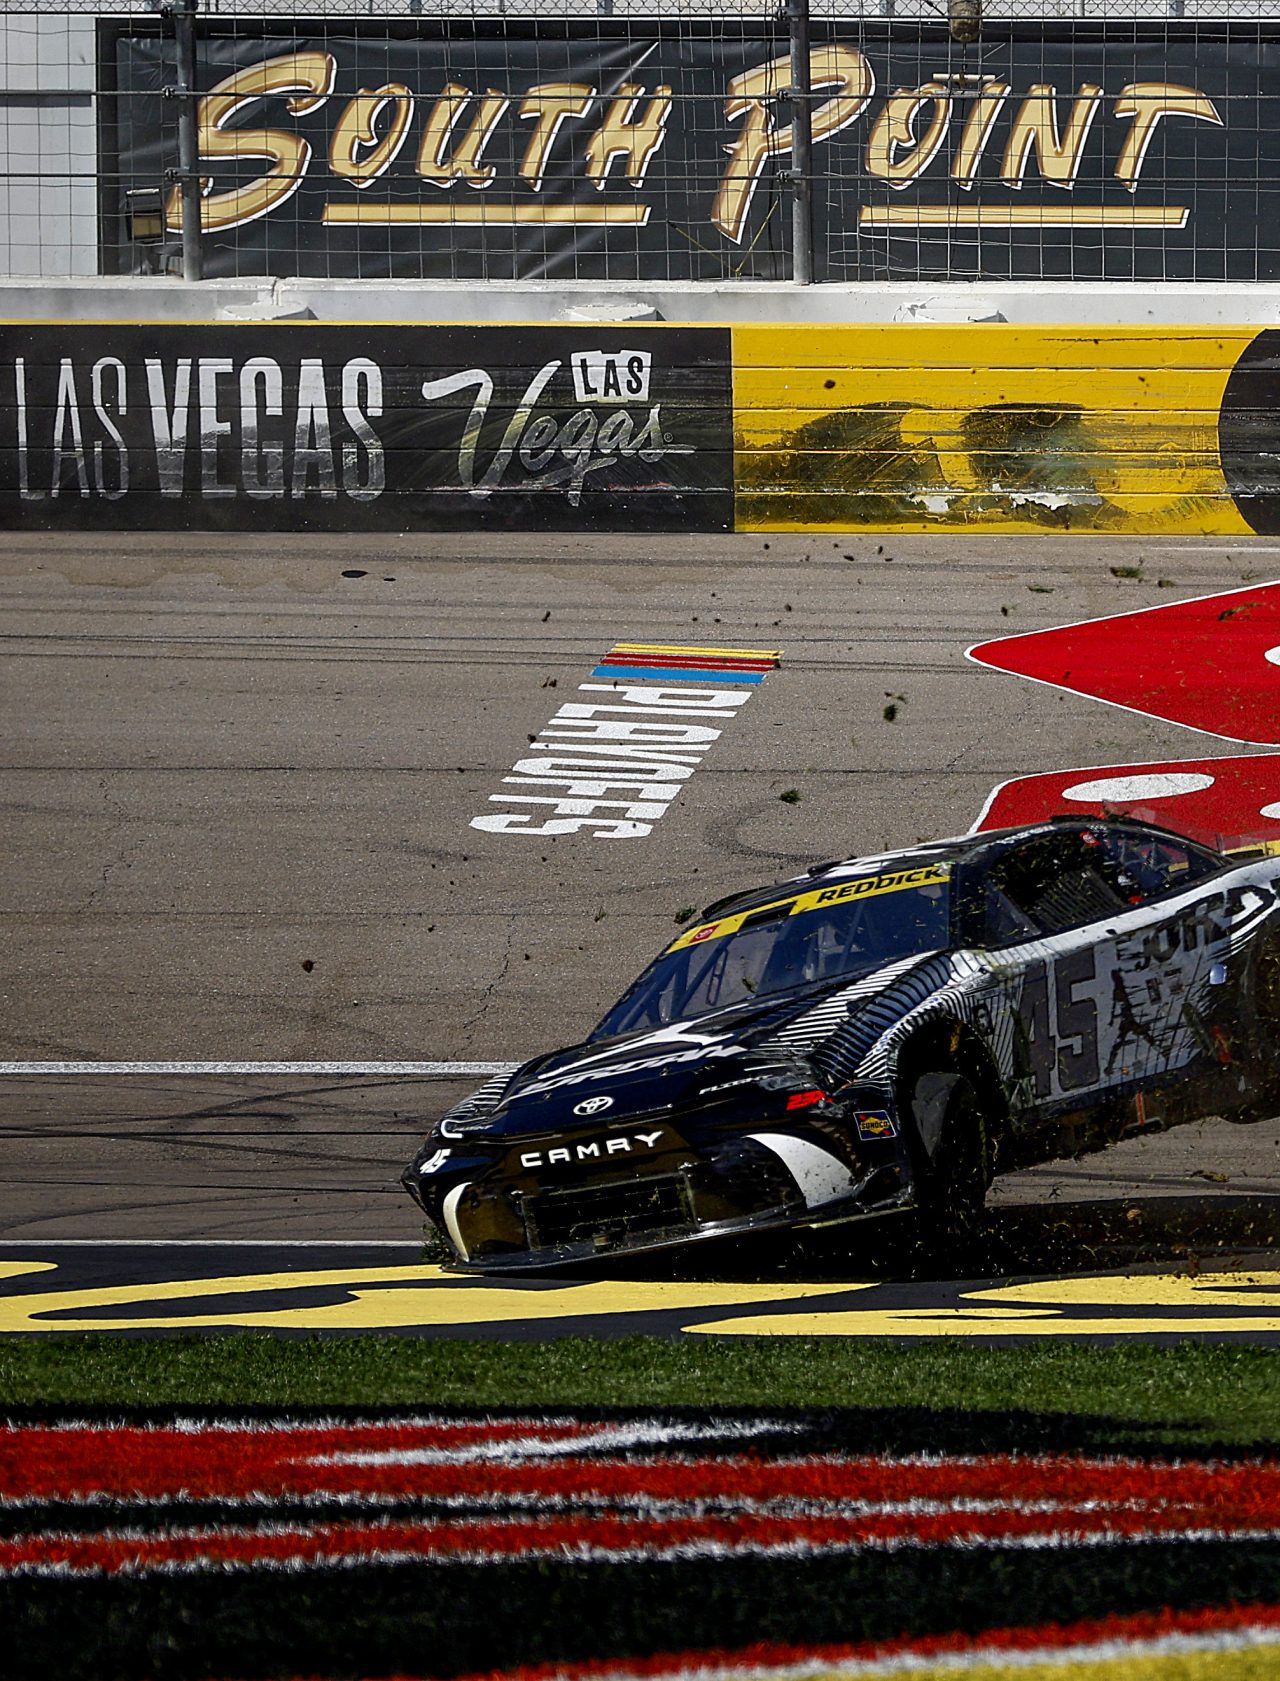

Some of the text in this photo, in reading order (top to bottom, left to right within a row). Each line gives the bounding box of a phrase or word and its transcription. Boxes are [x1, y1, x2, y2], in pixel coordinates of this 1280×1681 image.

[167, 52, 673, 233] SOUTH
[711, 44, 1223, 244] POINT
[580, 357, 643, 397] LAS
[14, 357, 386, 499] LAS VEGAS
[468, 683, 753, 839] PLAYOFFS
[816, 867, 941, 904] REDDICK
[860, 1120, 889, 1130] SUNOCO
[520, 1130, 664, 1168] CAMRY
